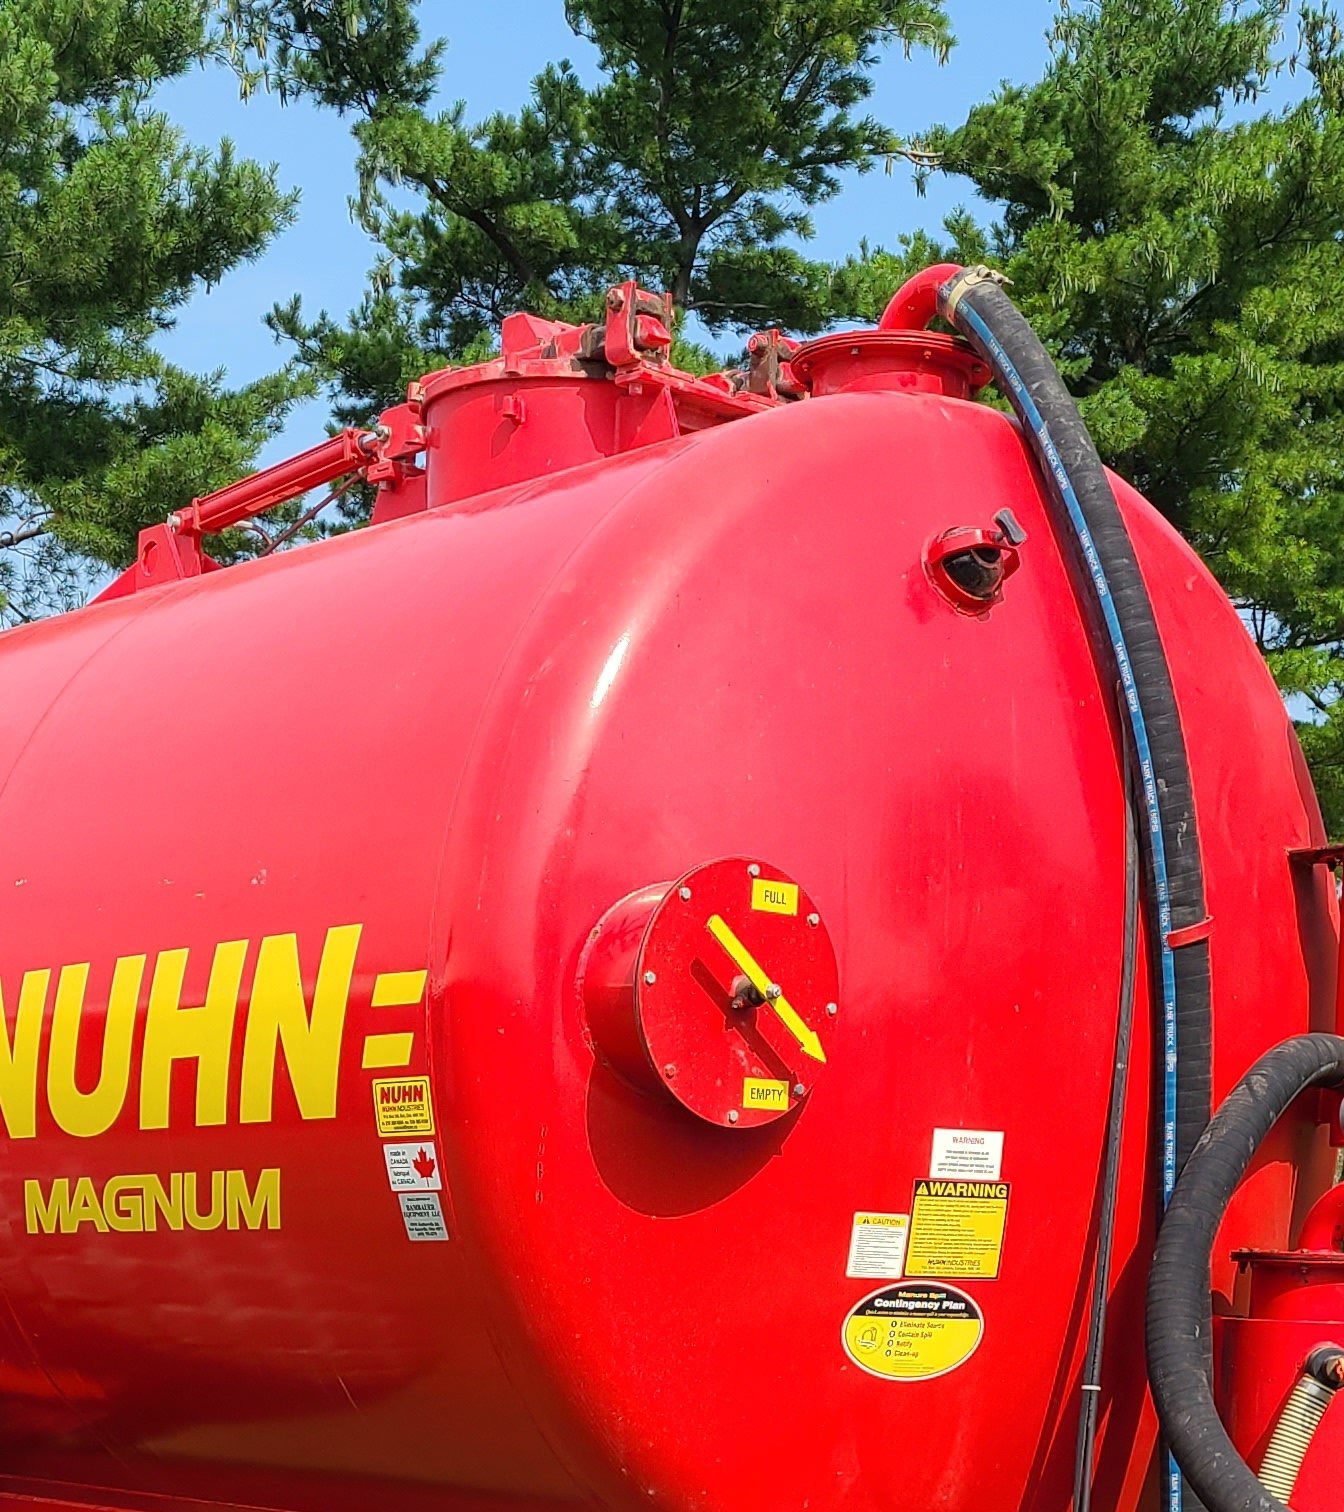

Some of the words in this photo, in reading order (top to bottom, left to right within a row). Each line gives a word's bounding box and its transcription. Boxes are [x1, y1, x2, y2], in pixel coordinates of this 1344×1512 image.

[764, 890, 786, 904] FULL
[380, 1084, 424, 1104] NUHN
[750, 1088, 783, 1101] EMPTY
[952, 1136, 985, 1144] WARNING
[929, 1182, 1008, 1198] WARNING
[24, 1168, 282, 1234] MAGNUM
[872, 1218, 900, 1226] CAUTION
[874, 1298, 941, 1310] Contingency
[942, 1300, 966, 1310] Plan
